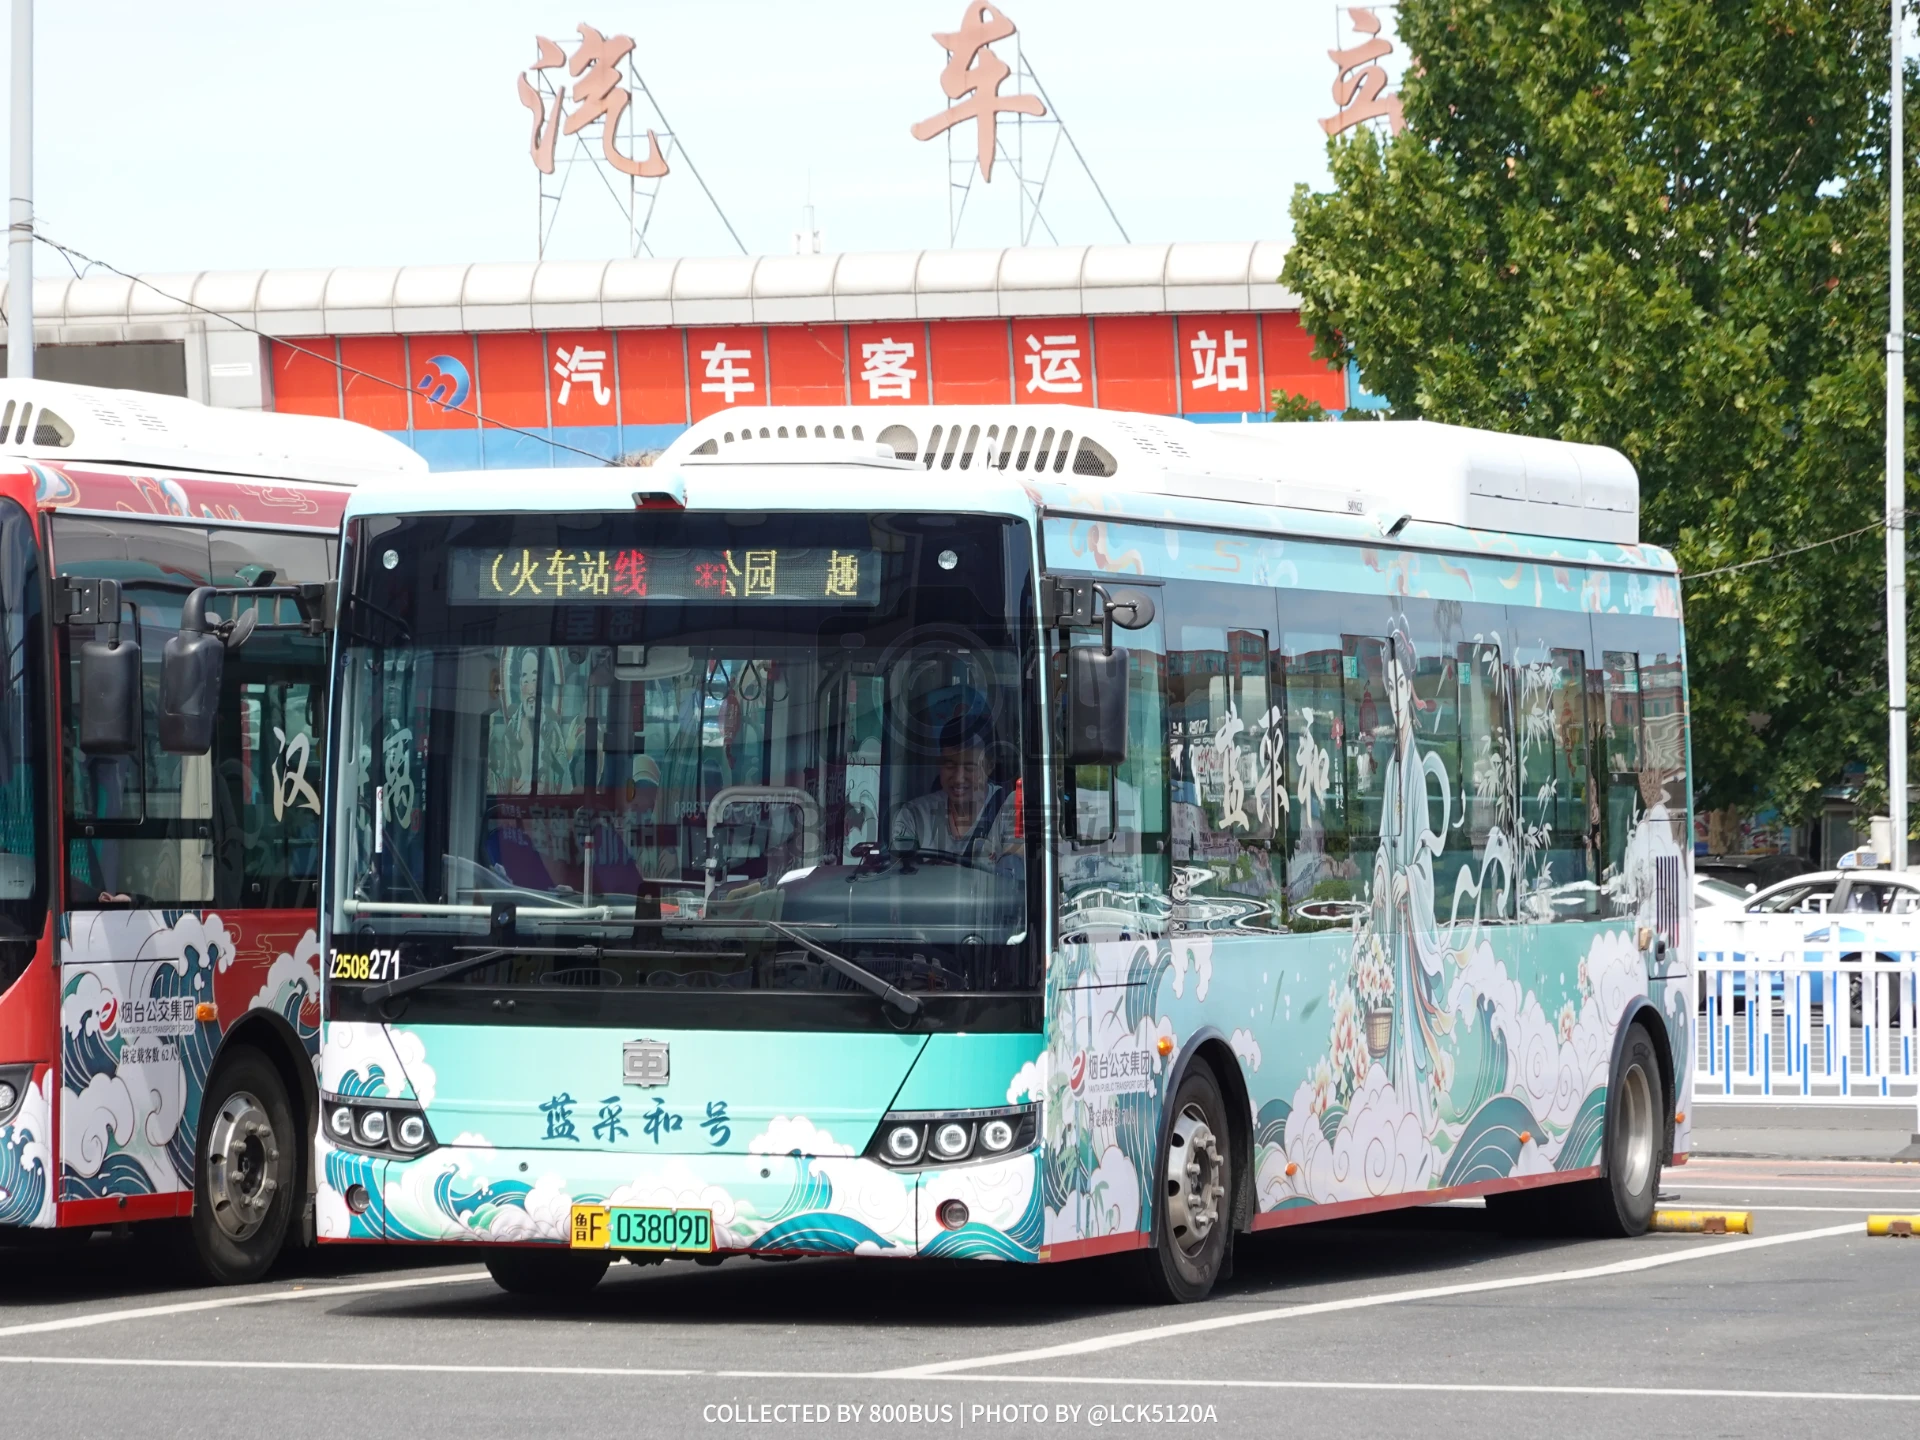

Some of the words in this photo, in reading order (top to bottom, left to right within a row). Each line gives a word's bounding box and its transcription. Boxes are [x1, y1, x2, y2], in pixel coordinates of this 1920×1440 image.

[554, 331, 1248, 406] 汽车客运站
[121, 1000, 195, 1023] 烟台公交集团
[136, 1025, 152, 1034] PUBLIC
[152, 1024, 178, 1034] TRANSPORT
[1089, 1051, 1150, 1080] 烟台公交集团
[538, 1092, 731, 1147] 蓝采和号
[617, 1213, 709, 1245] 03809D
